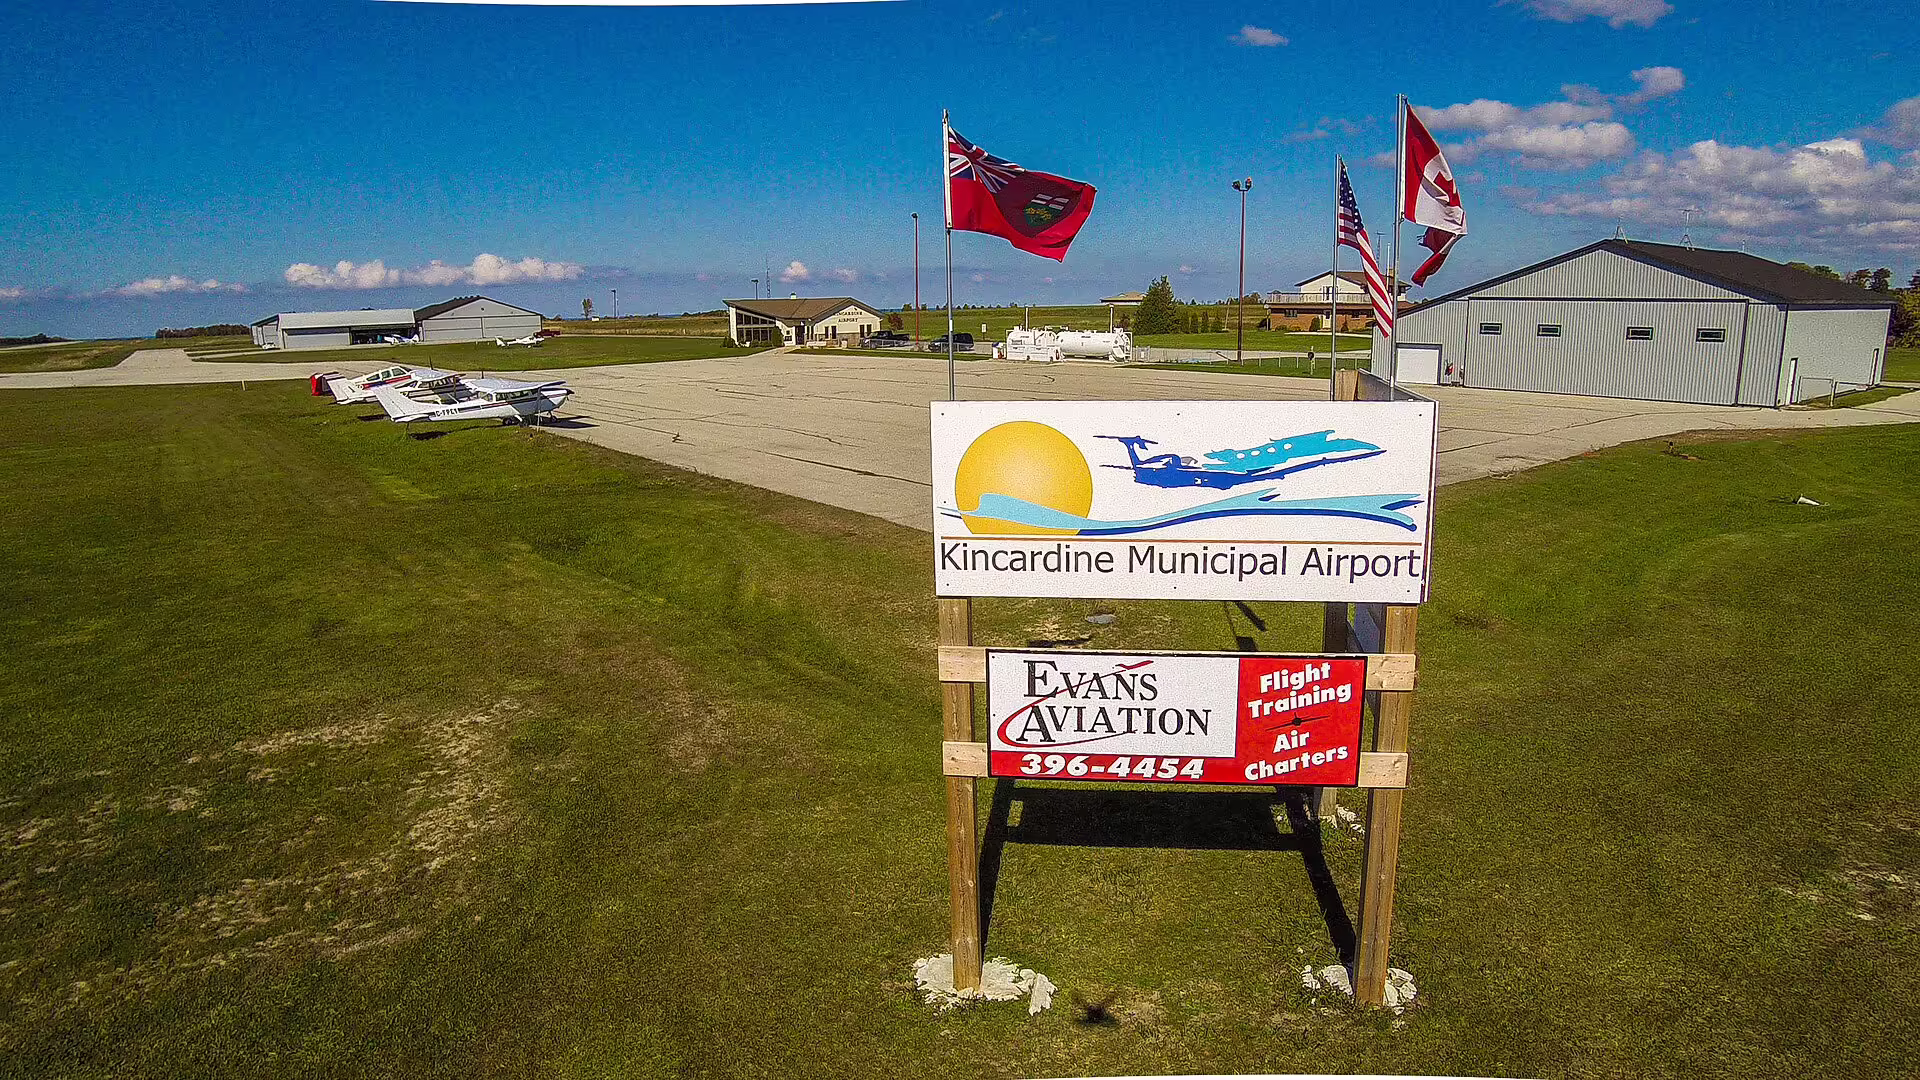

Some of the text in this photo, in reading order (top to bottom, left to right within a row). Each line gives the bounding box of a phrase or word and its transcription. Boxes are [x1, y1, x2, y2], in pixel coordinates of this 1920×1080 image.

[940, 542, 1421, 584] Kincardine Municipal Airport
[1023, 659, 1158, 701] EVANS
[1260, 662, 1331, 694] Flight
[1247, 683, 1352, 719] Training
[1016, 704, 1212, 742] AVIATION
[1273, 729, 1310, 754] Air
[1020, 753, 1205, 779] 396-4454
[1244, 745, 1349, 781] Charters
